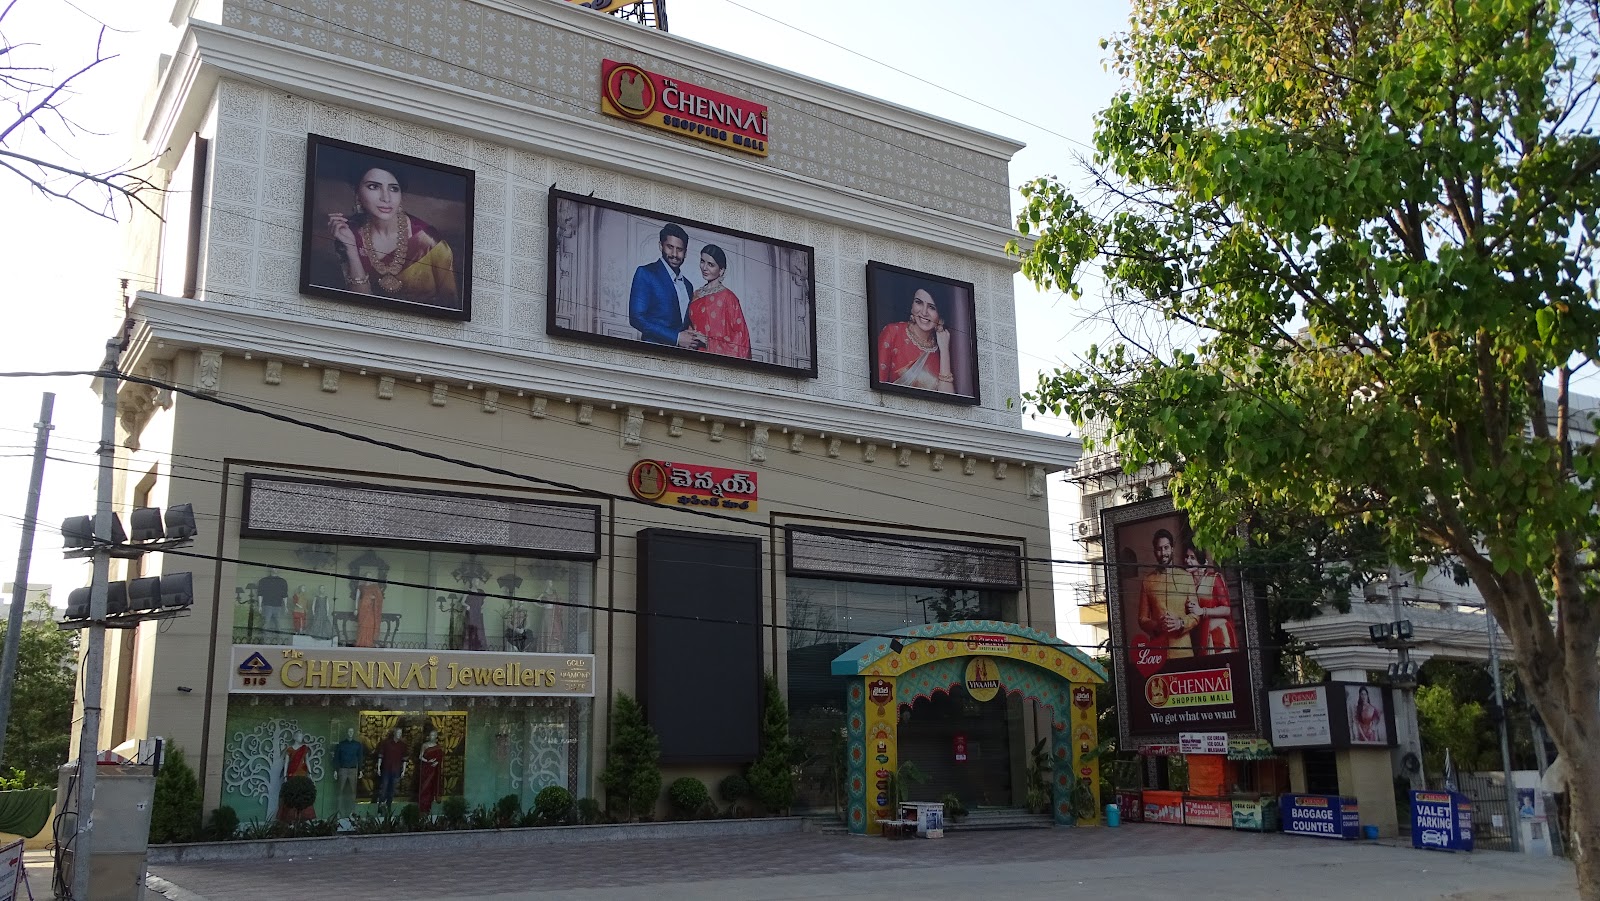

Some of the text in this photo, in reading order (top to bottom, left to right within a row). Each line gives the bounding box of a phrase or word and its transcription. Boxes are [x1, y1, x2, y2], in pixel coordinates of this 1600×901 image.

[664, 79, 679, 89] The
[663, 115, 765, 152] SHOPPING MALL
[282, 649, 304, 659] The
[1137, 648, 1162, 665] Love
[243, 677, 267, 686] BIS
[446, 662, 556, 690] Jewellers
[1171, 694, 1230, 704] SHOPPING MALL
[1150, 709, 1236, 725] We get what we want
[1291, 808, 1334, 820] BAGGAGE
[1416, 805, 1450, 817] VALET
[1292, 820, 1335, 833] COUNTER
[1417, 816, 1451, 829] PARKING
